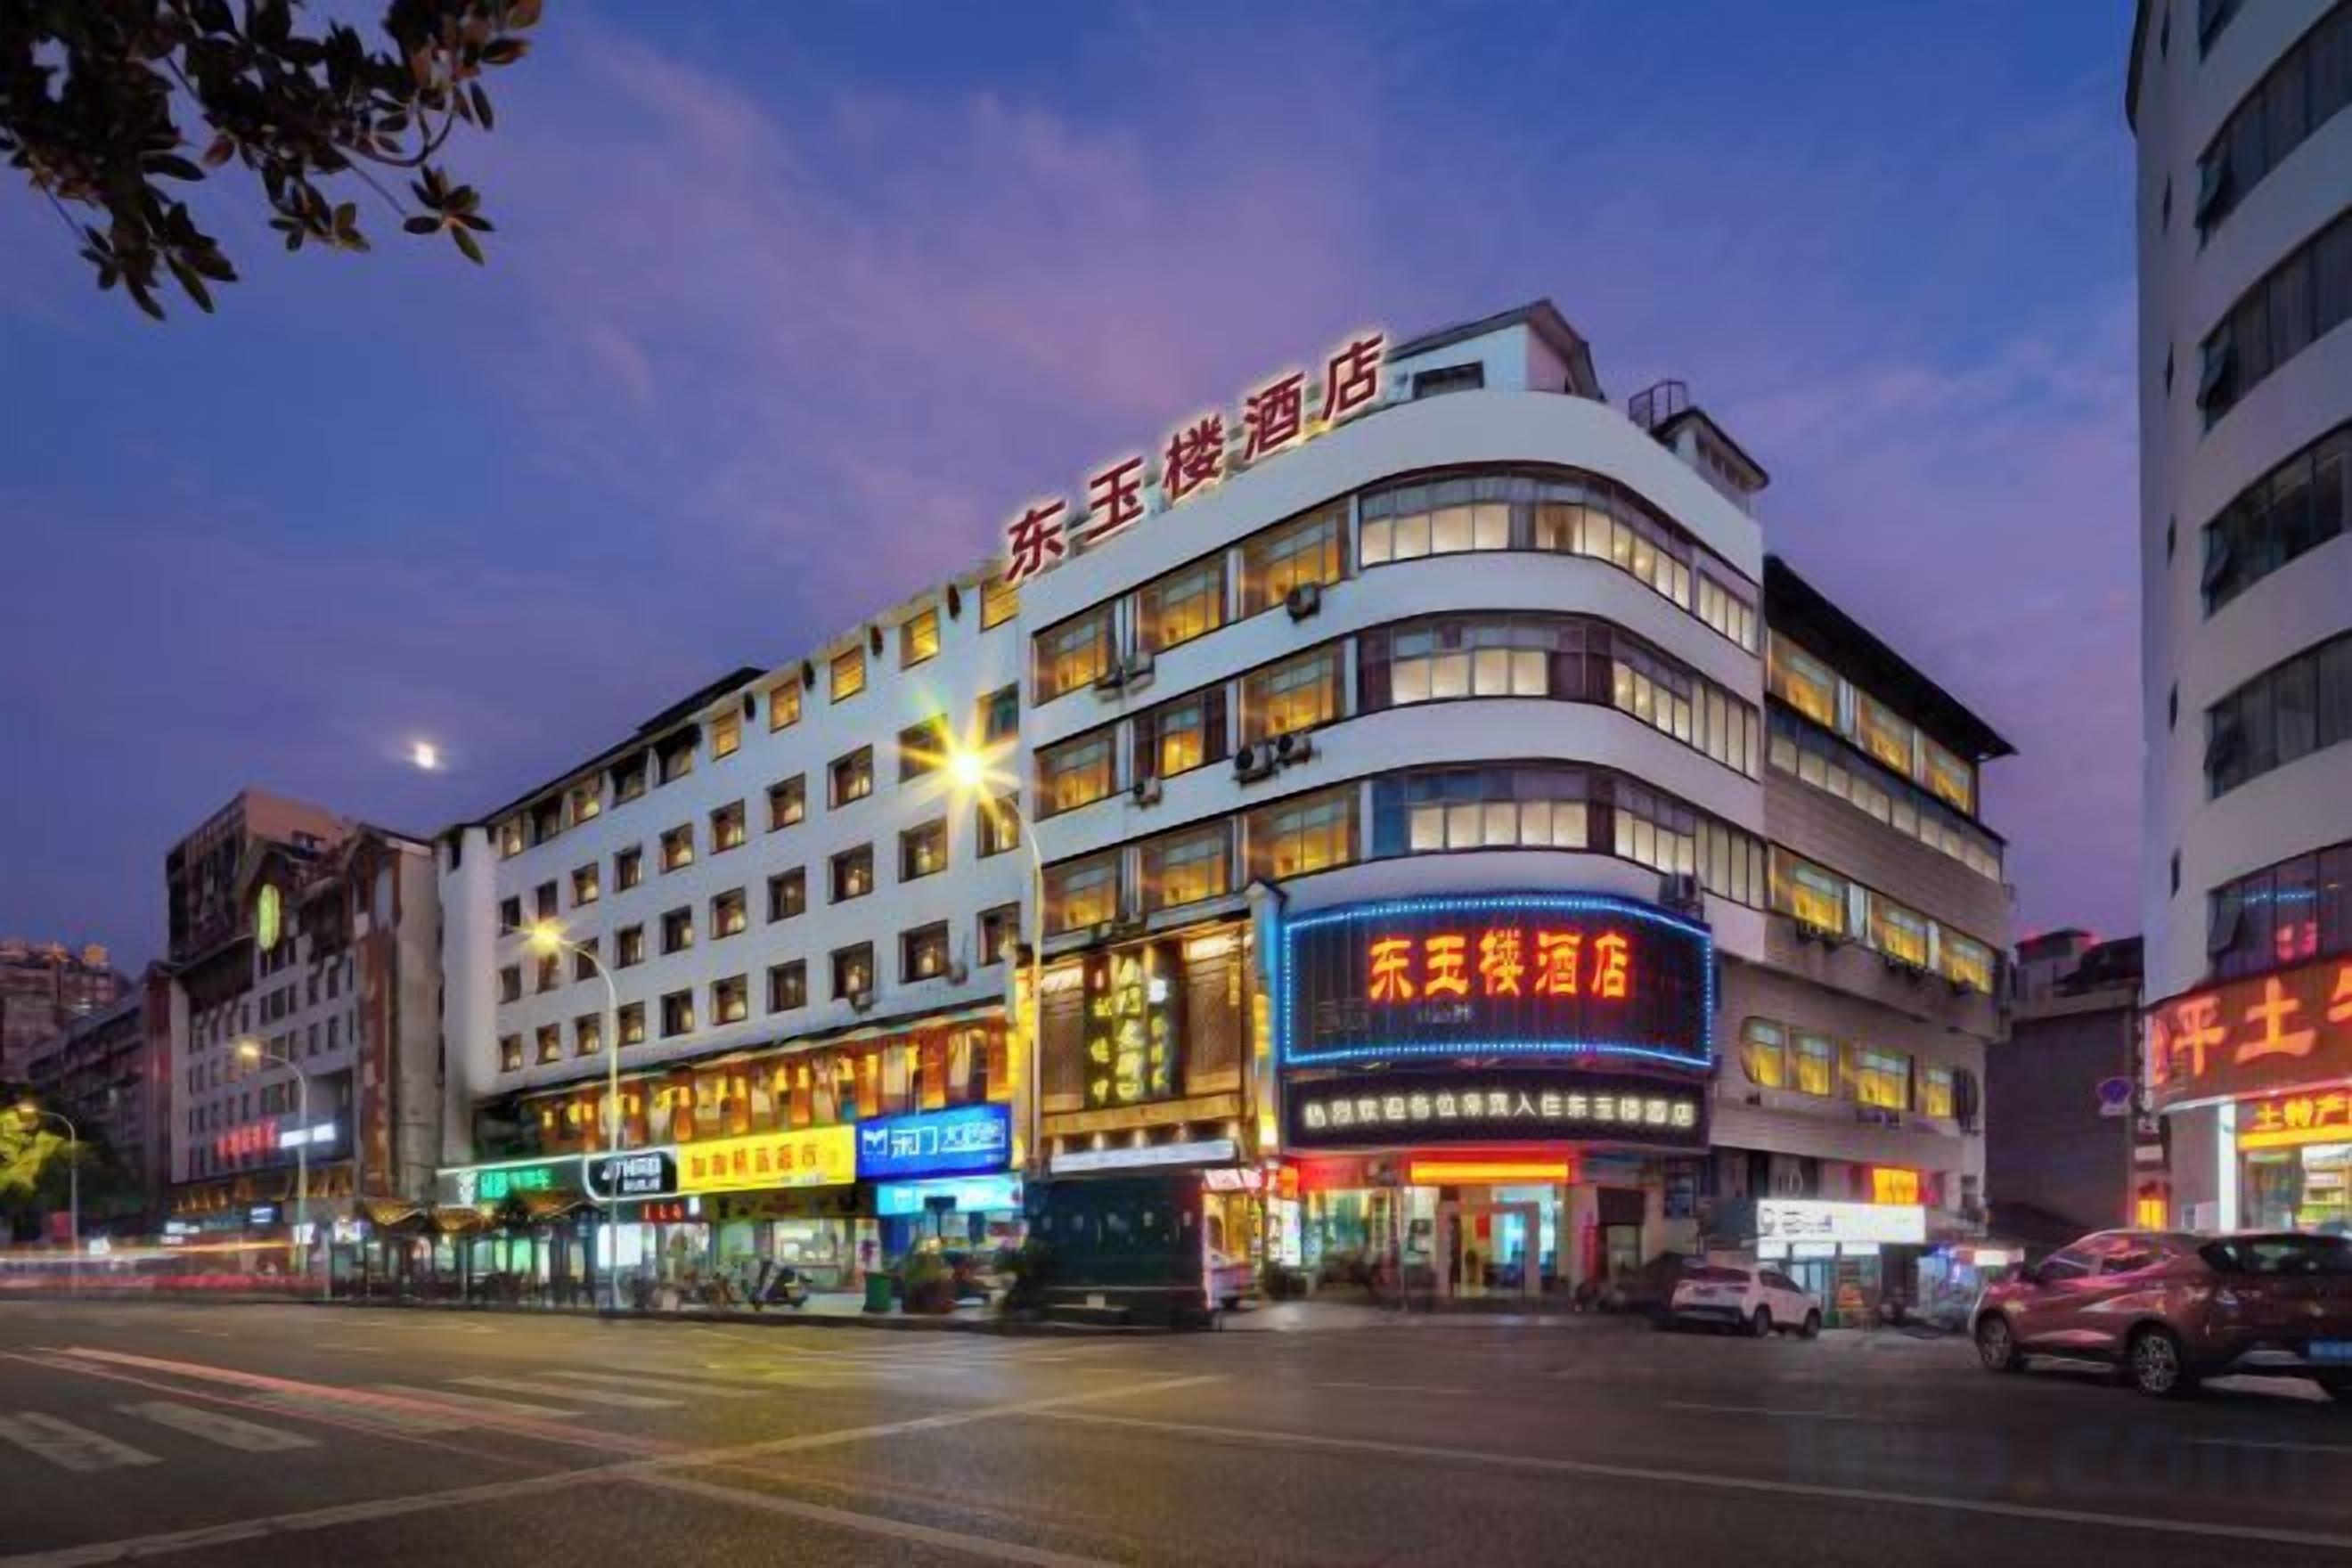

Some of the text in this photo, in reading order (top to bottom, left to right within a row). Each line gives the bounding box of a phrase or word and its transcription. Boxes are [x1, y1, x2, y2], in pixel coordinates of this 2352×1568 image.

[1004, 333, 1384, 583] 东玉楼酒店
[1369, 929, 1628, 1000] 东玉楼酒店
[2251, 1089, 2352, 1131] 土特产
